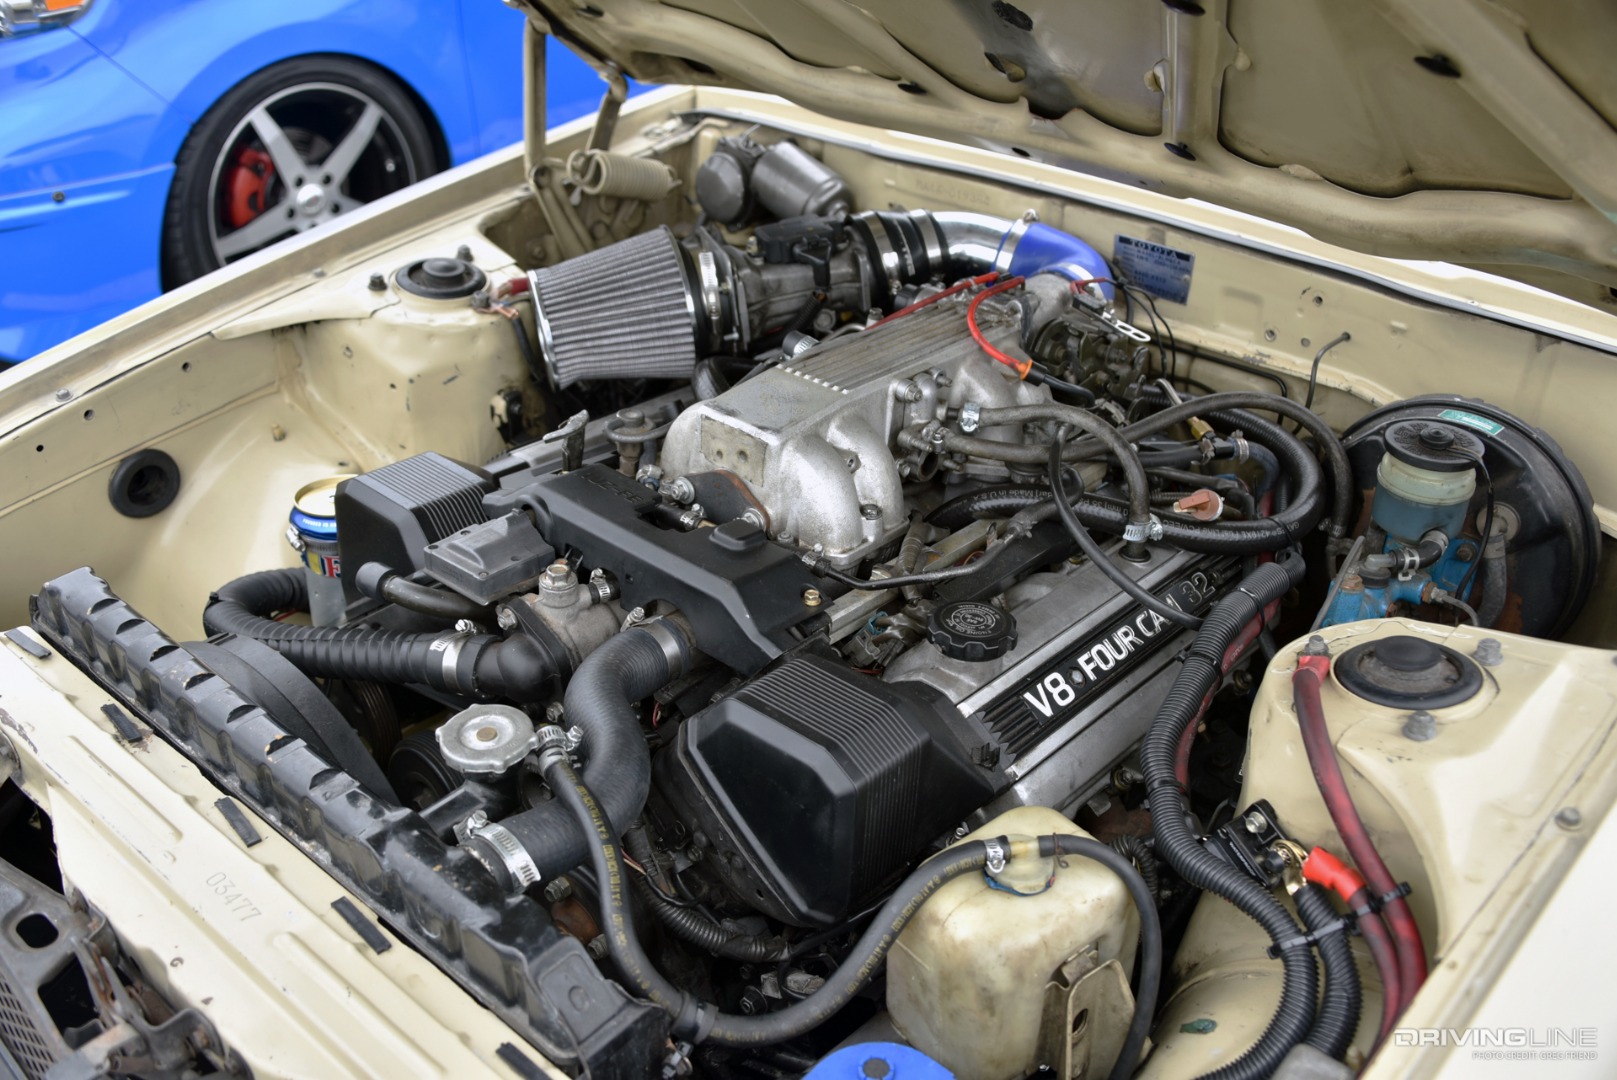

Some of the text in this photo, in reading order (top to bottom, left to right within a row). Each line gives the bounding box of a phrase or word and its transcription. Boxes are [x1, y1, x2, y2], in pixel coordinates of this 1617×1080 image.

[1130, 239, 1177, 258] TOYOTA
[1008, 489, 1033, 498] Made
[1023, 571, 1216, 718] V8 FOUR CA 32
[206, 871, 262, 921] 03477
